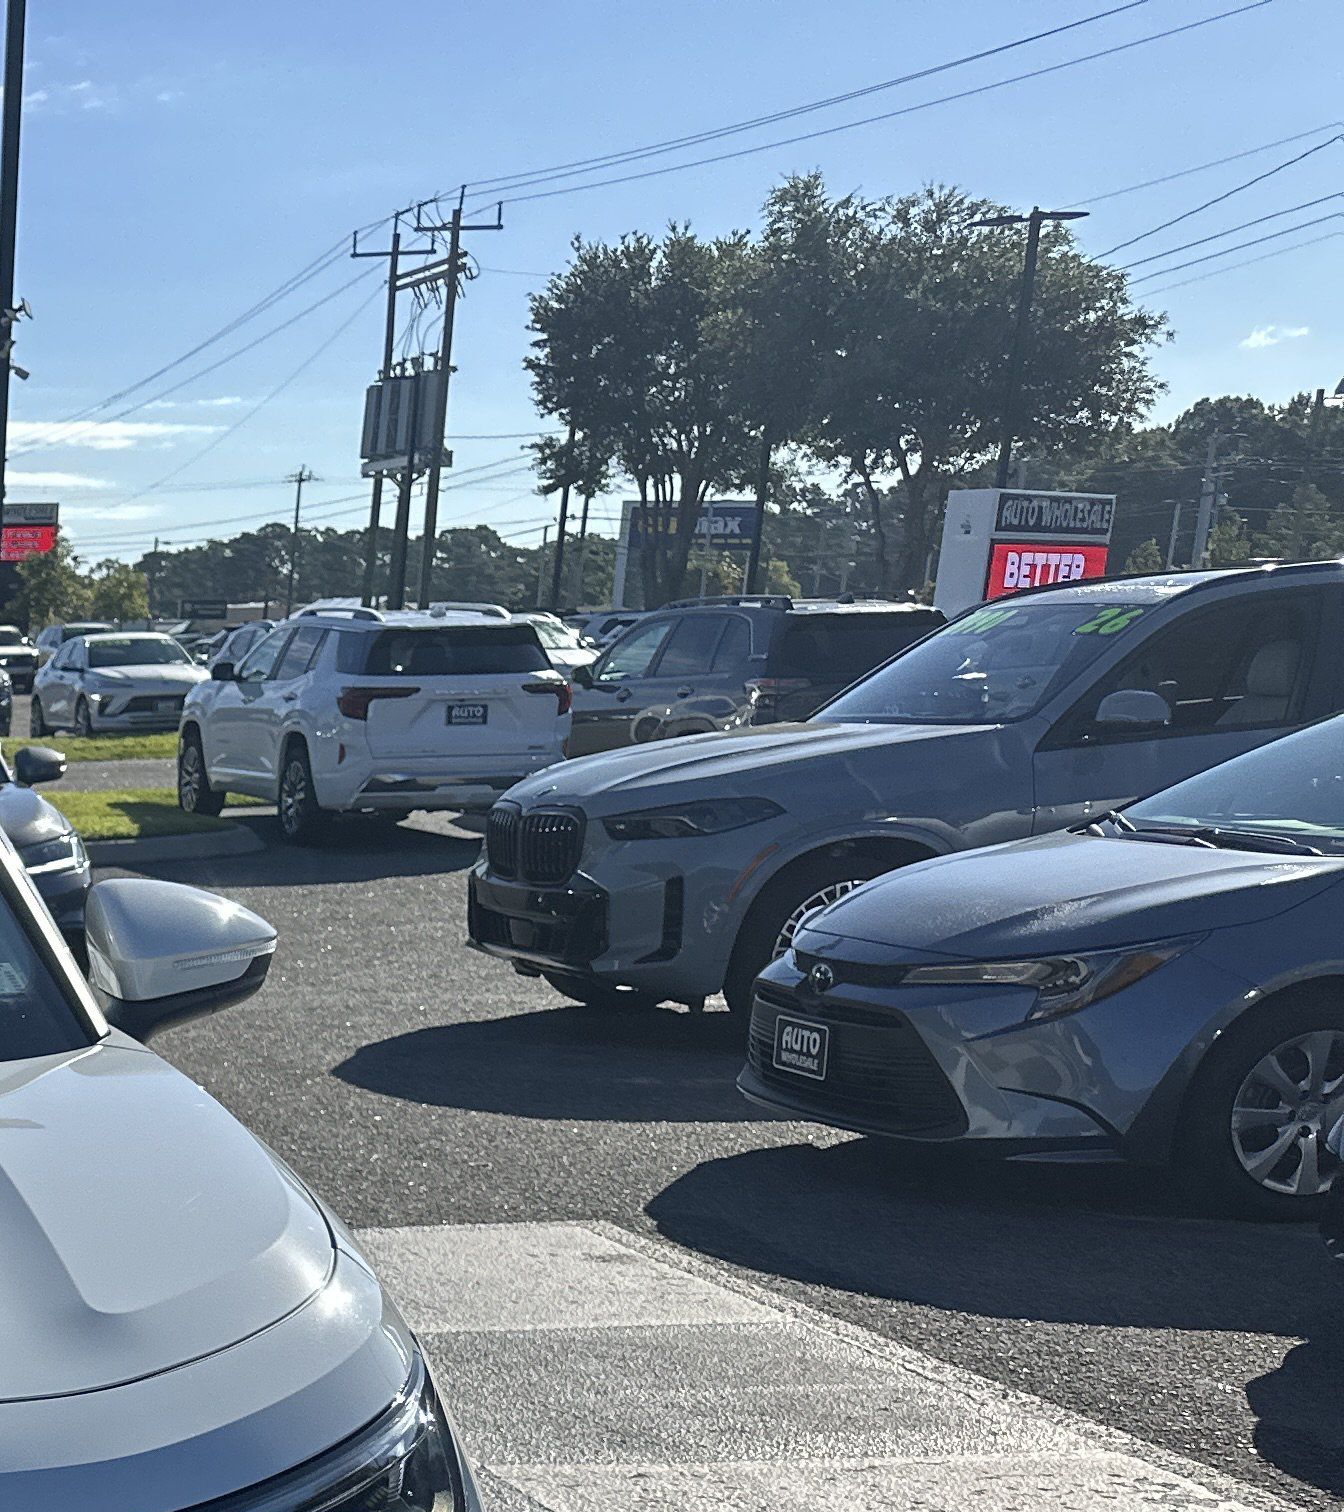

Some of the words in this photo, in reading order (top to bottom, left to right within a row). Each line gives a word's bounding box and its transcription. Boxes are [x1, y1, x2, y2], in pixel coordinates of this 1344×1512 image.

[1001, 500, 1039, 527] AUTO
[1041, 500, 1112, 530] WHOLESALE
[1003, 551, 1086, 588] BETTER
[1075, 608, 1143, 635] 26
[782, 1026, 820, 1055] AUTO
